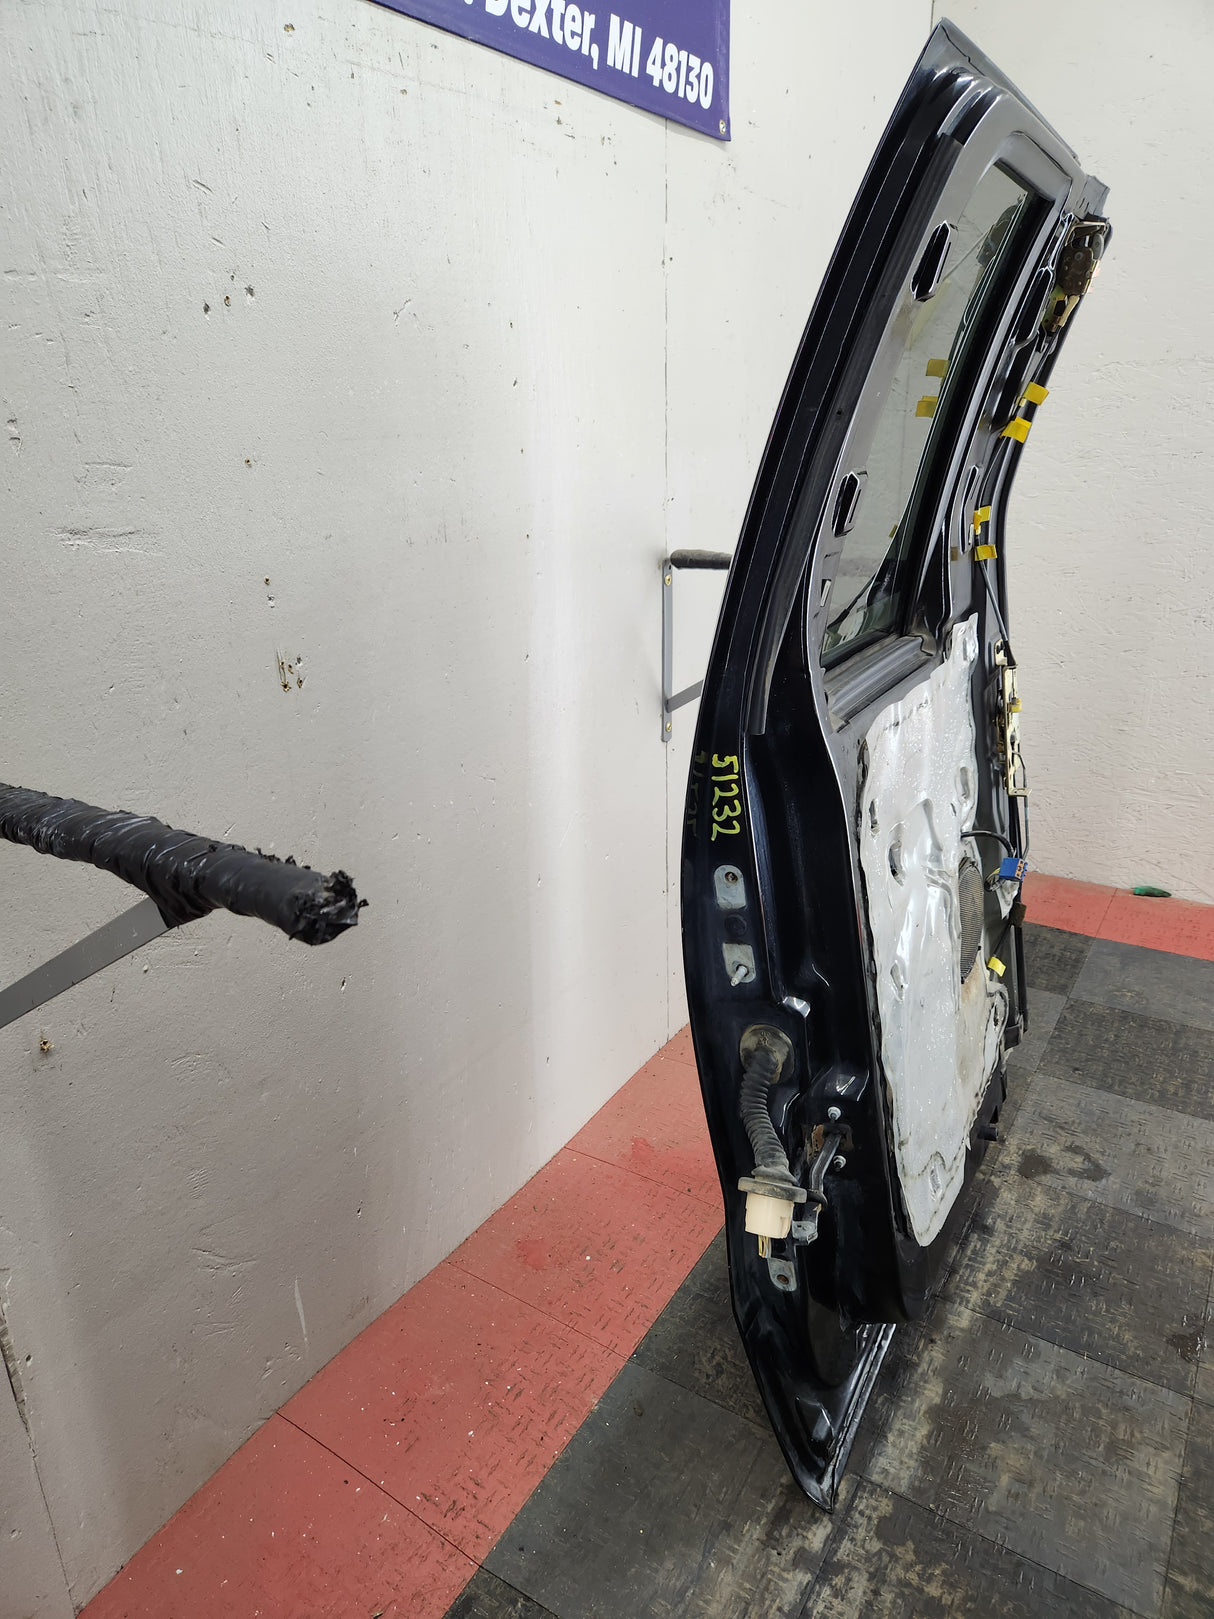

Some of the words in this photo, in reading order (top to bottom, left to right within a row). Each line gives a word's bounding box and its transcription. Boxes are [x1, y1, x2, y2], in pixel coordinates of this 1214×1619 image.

[485, 0, 599, 70] exter,
[606, 13, 642, 78] MI
[646, 36, 714, 110] 48130
[711, 753, 742, 841] 51232
